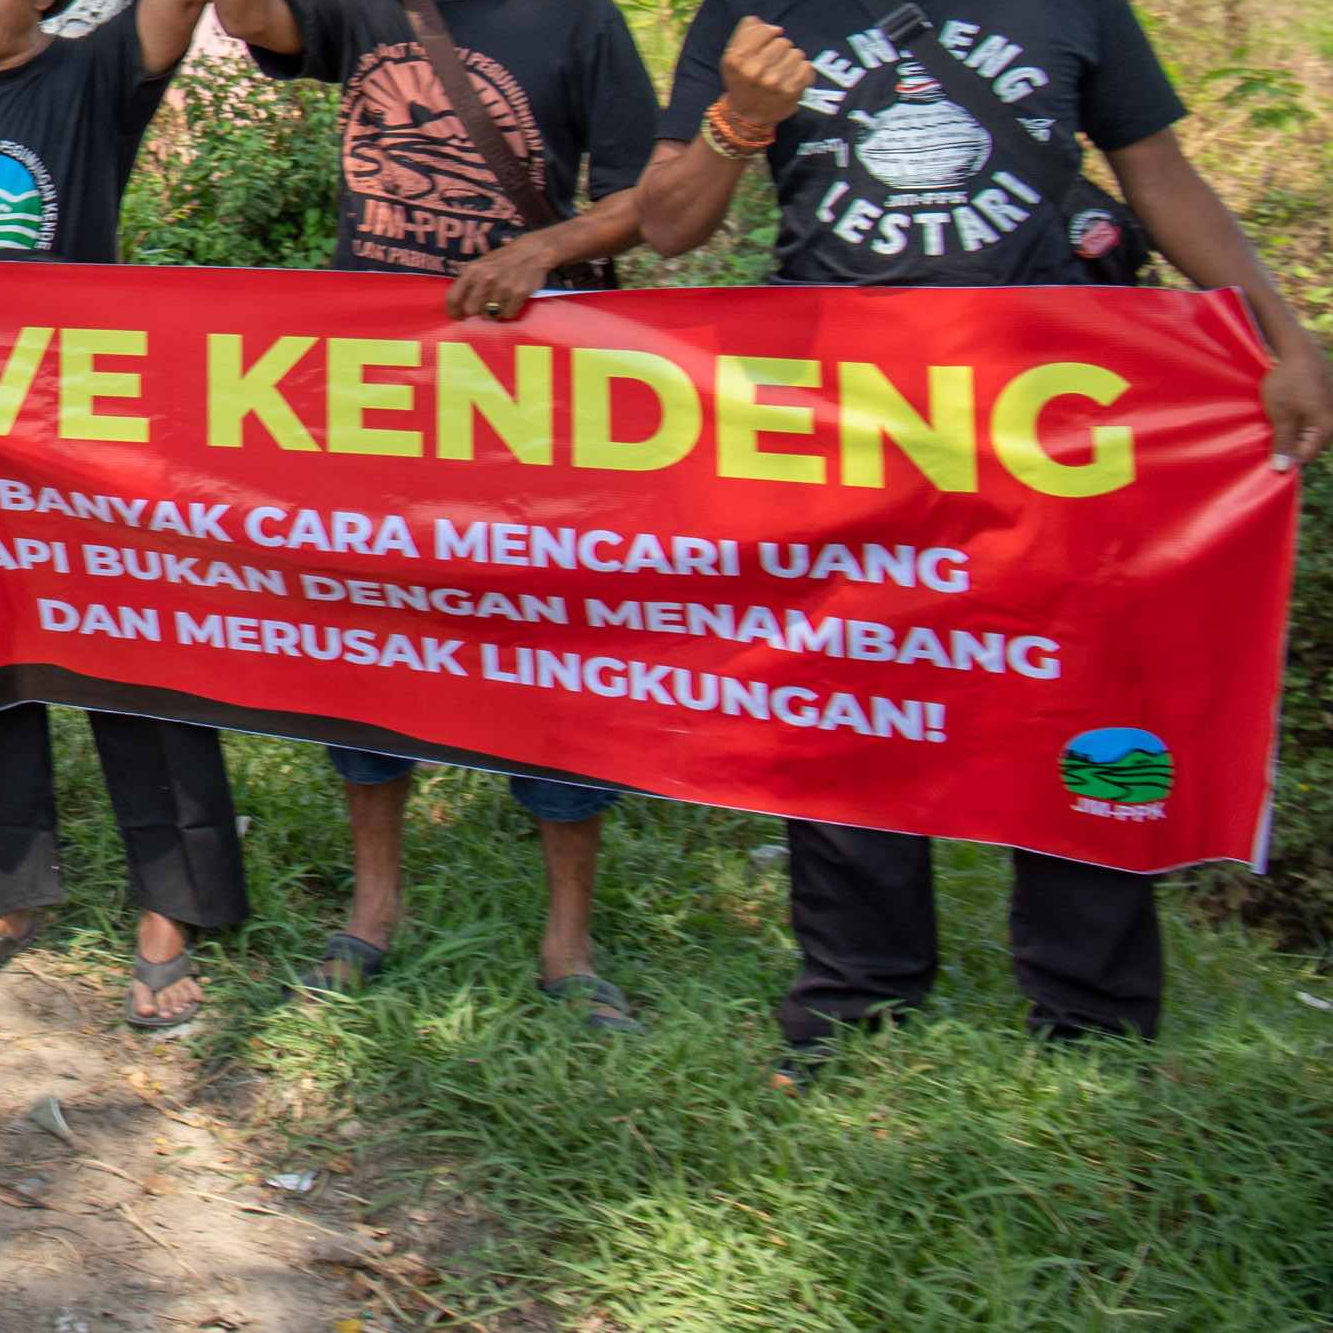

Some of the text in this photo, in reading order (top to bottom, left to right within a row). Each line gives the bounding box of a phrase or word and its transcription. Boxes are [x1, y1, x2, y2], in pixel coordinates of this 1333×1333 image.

[797, 19, 1050, 116] KENENG
[357, 199, 494, 254] JM-PPK
[816, 171, 1041, 256] LESTARI
[207, 333, 1136, 498] KENDENG
[244, 506, 420, 558] CARA
[434, 518, 740, 577] MENCARI
[757, 542, 970, 594] UANG
[83, 544, 288, 597] BUKAN
[300, 574, 569, 625] DENGAN
[585, 598, 1061, 680] MENAMBANG
[37, 598, 947, 744] DAN MERUSAK LINGKUNGAN!
